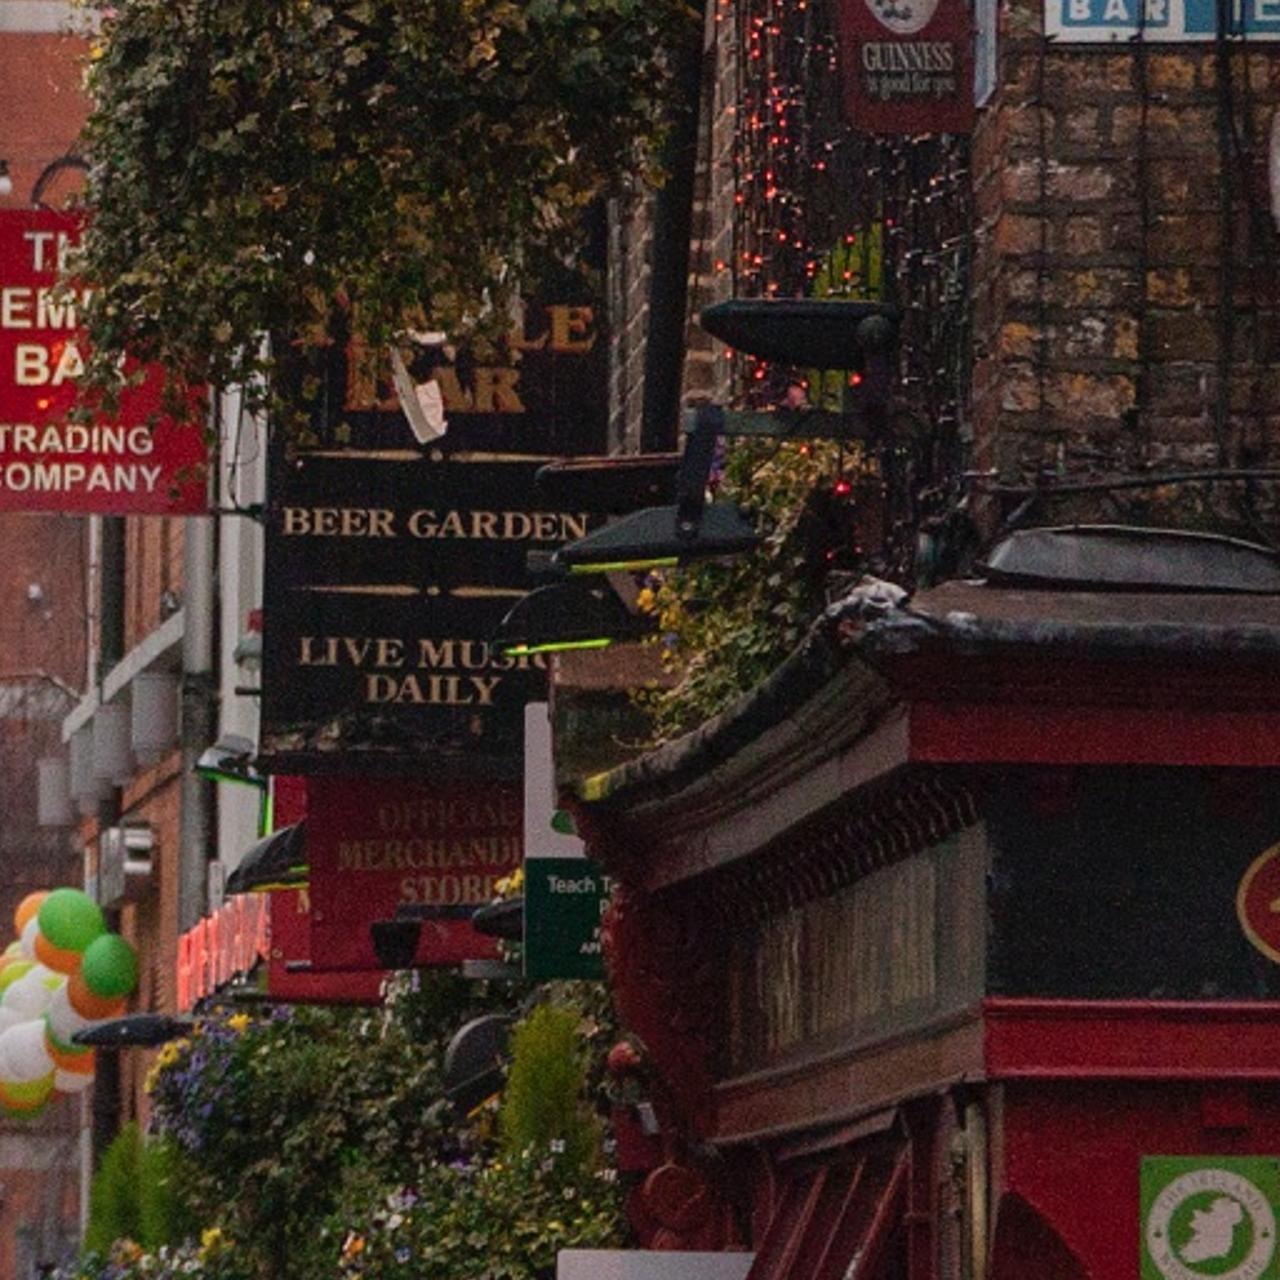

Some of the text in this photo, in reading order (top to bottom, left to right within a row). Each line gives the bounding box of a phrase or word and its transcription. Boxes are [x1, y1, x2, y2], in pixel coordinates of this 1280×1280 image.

[862, 41, 955, 72] GUINNESS
[23, 231, 88, 272] TH
[281, 506, 590, 541] BEER GARDEN
[298, 636, 404, 667] LIVE
[364, 674, 503, 706] DAILY
[337, 836, 524, 871] MERCHANDI
[546, 874, 596, 894] Teach
